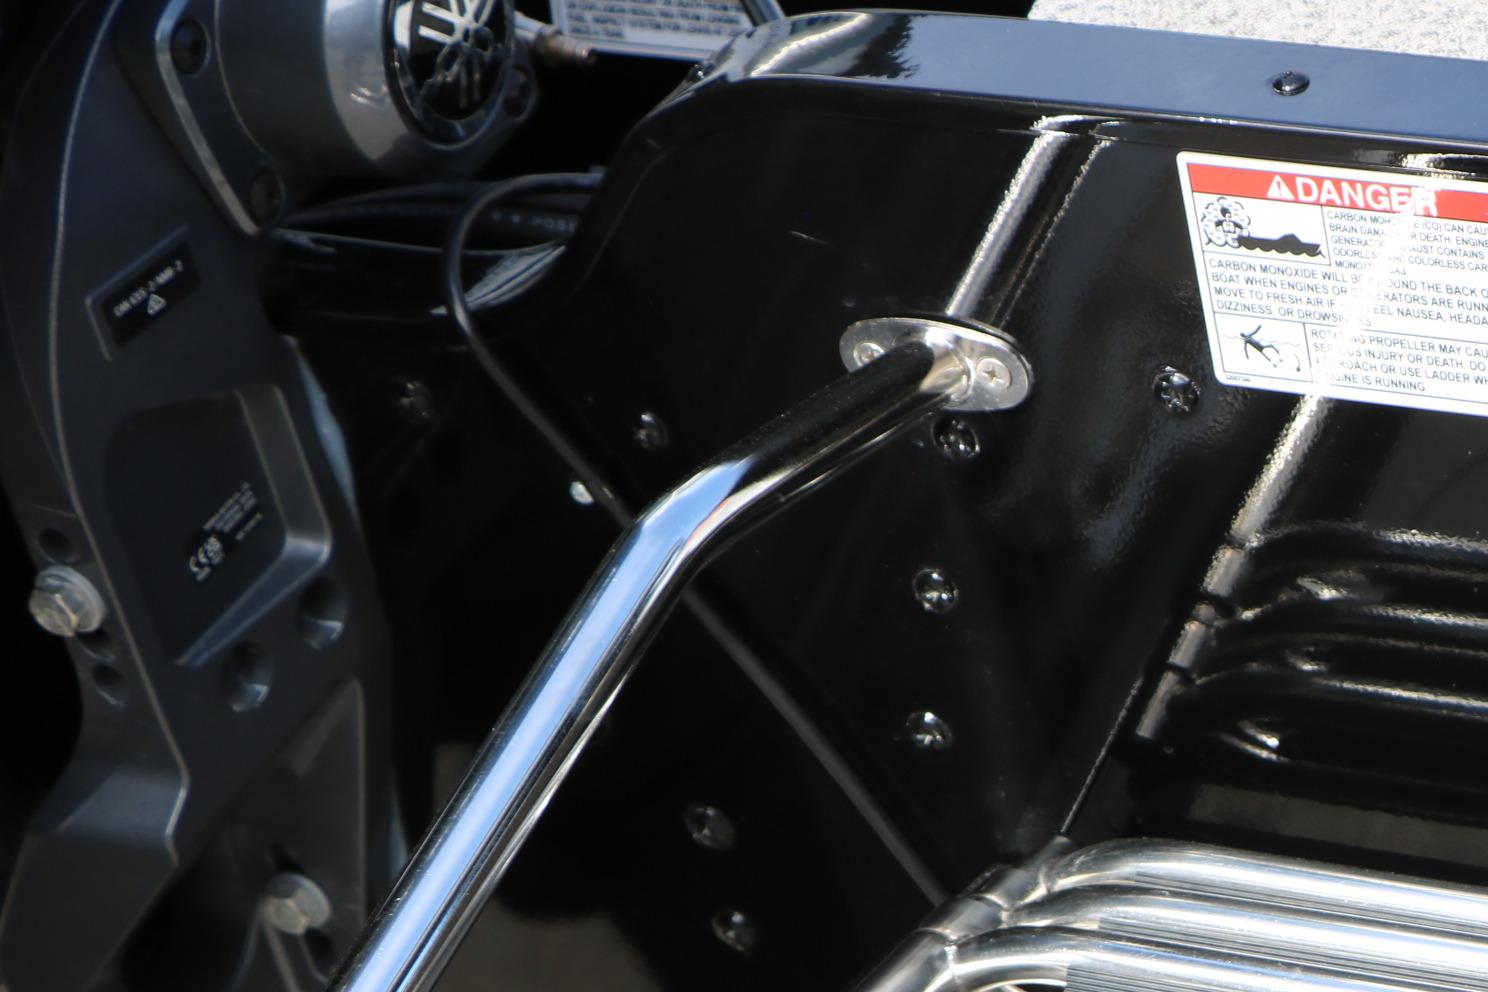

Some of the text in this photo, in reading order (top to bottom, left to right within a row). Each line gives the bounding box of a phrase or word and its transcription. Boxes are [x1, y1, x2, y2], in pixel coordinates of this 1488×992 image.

[1295, 176, 1438, 217] DANGER
[1327, 210, 1367, 222] CARBON
[1444, 223, 1465, 233] CAN
[1329, 222, 1358, 233] BRAIN
[1408, 255, 1466, 270] COLORLESS
[1437, 247, 1485, 260] CONTAINS
[1209, 258, 1256, 272] CARBON
[1260, 264, 1318, 280] MONOXIDE
[1321, 271, 1348, 283] WILL
[1420, 281, 1442, 293] THE
[1446, 284, 1478, 297] BACK
[1211, 272, 1240, 284] BOAT
[1244, 275, 1277, 288] WHEN
[1280, 279, 1329, 295] ENGINES
[1332, 285, 1348, 296] OR
[1431, 297, 1454, 309] ARE
[1214, 286, 1246, 298] MOVE
[1249, 289, 1264, 301] TO
[1266, 292, 1303, 305] FRESH
[1306, 297, 1324, 308] AIR
[1327, 299, 1336, 309] IF
[1278, 307, 1294, 318] OR
[1369, 335, 1435, 351] PROPELLER
[1439, 343, 1461, 354] MAY
[1364, 349, 1403, 362] INJURY
[1407, 353, 1423, 364] OR
[1469, 360, 1486, 372] DO
[1362, 375, 1372, 385] IS
[1380, 363, 1396, 374] OR
[1400, 366, 1422, 378] USE
[1425, 369, 1470, 383] LADDER
